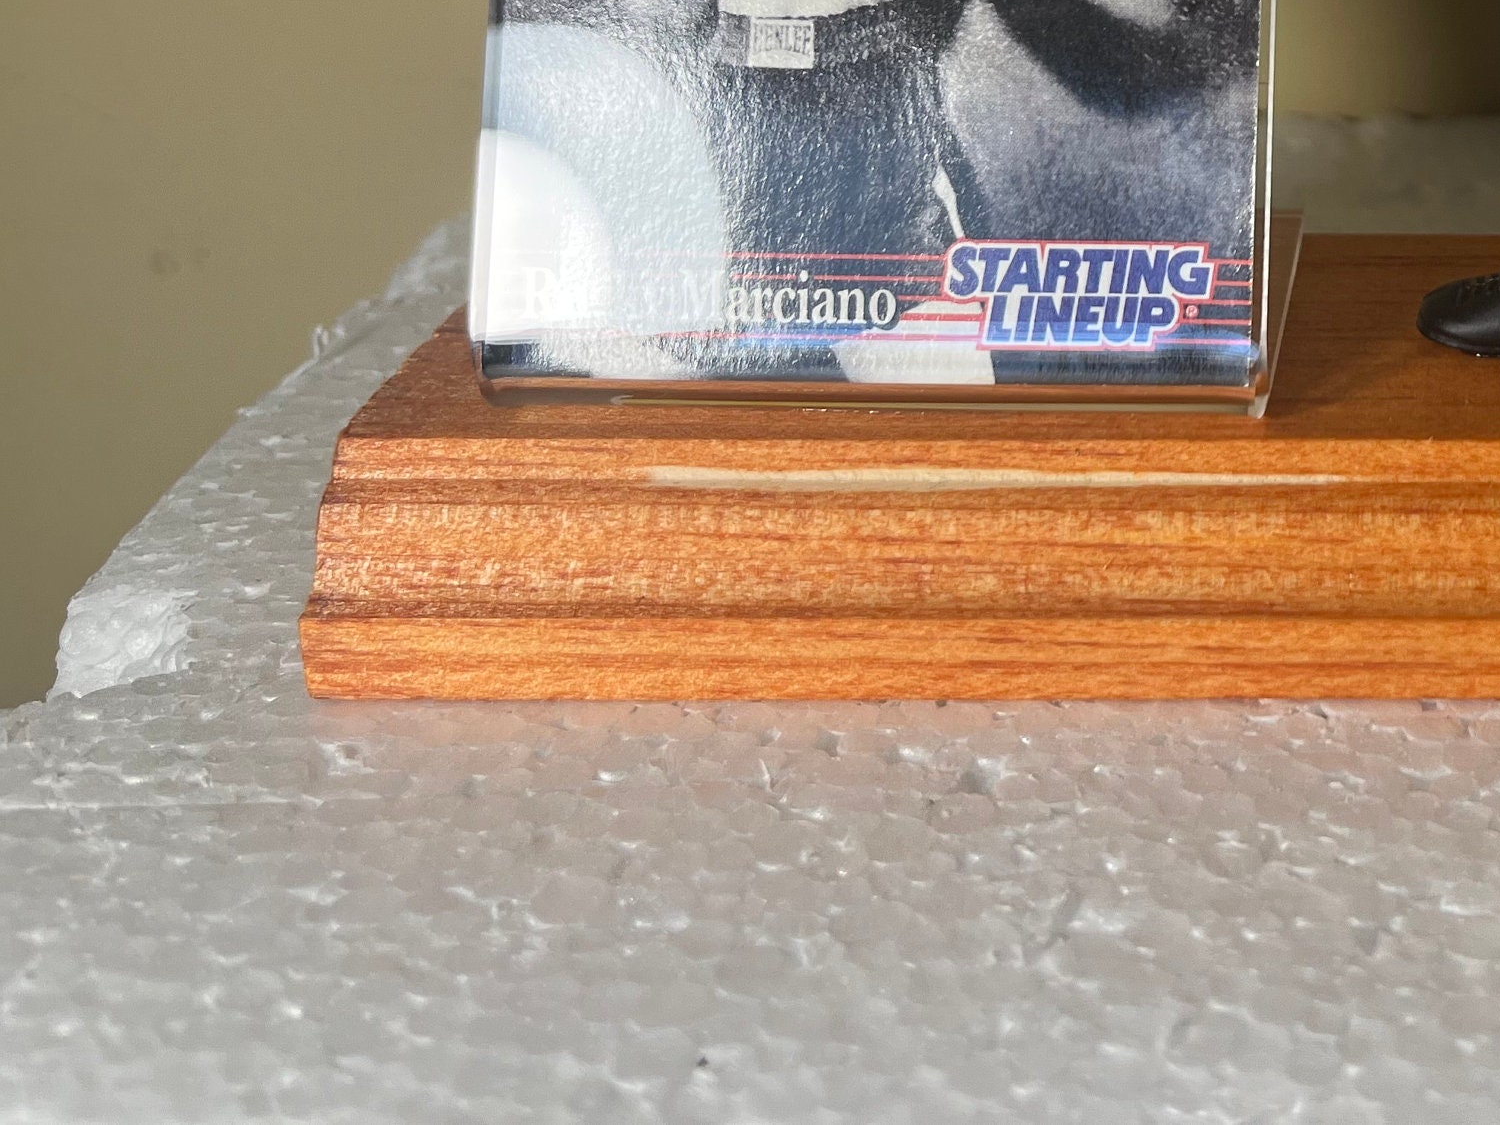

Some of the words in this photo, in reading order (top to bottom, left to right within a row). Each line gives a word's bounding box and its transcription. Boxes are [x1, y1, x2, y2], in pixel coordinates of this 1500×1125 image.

[678, 268, 898, 327] Marciano
[949, 245, 1213, 298] STARTING
[986, 295, 1178, 344] LINEUP
